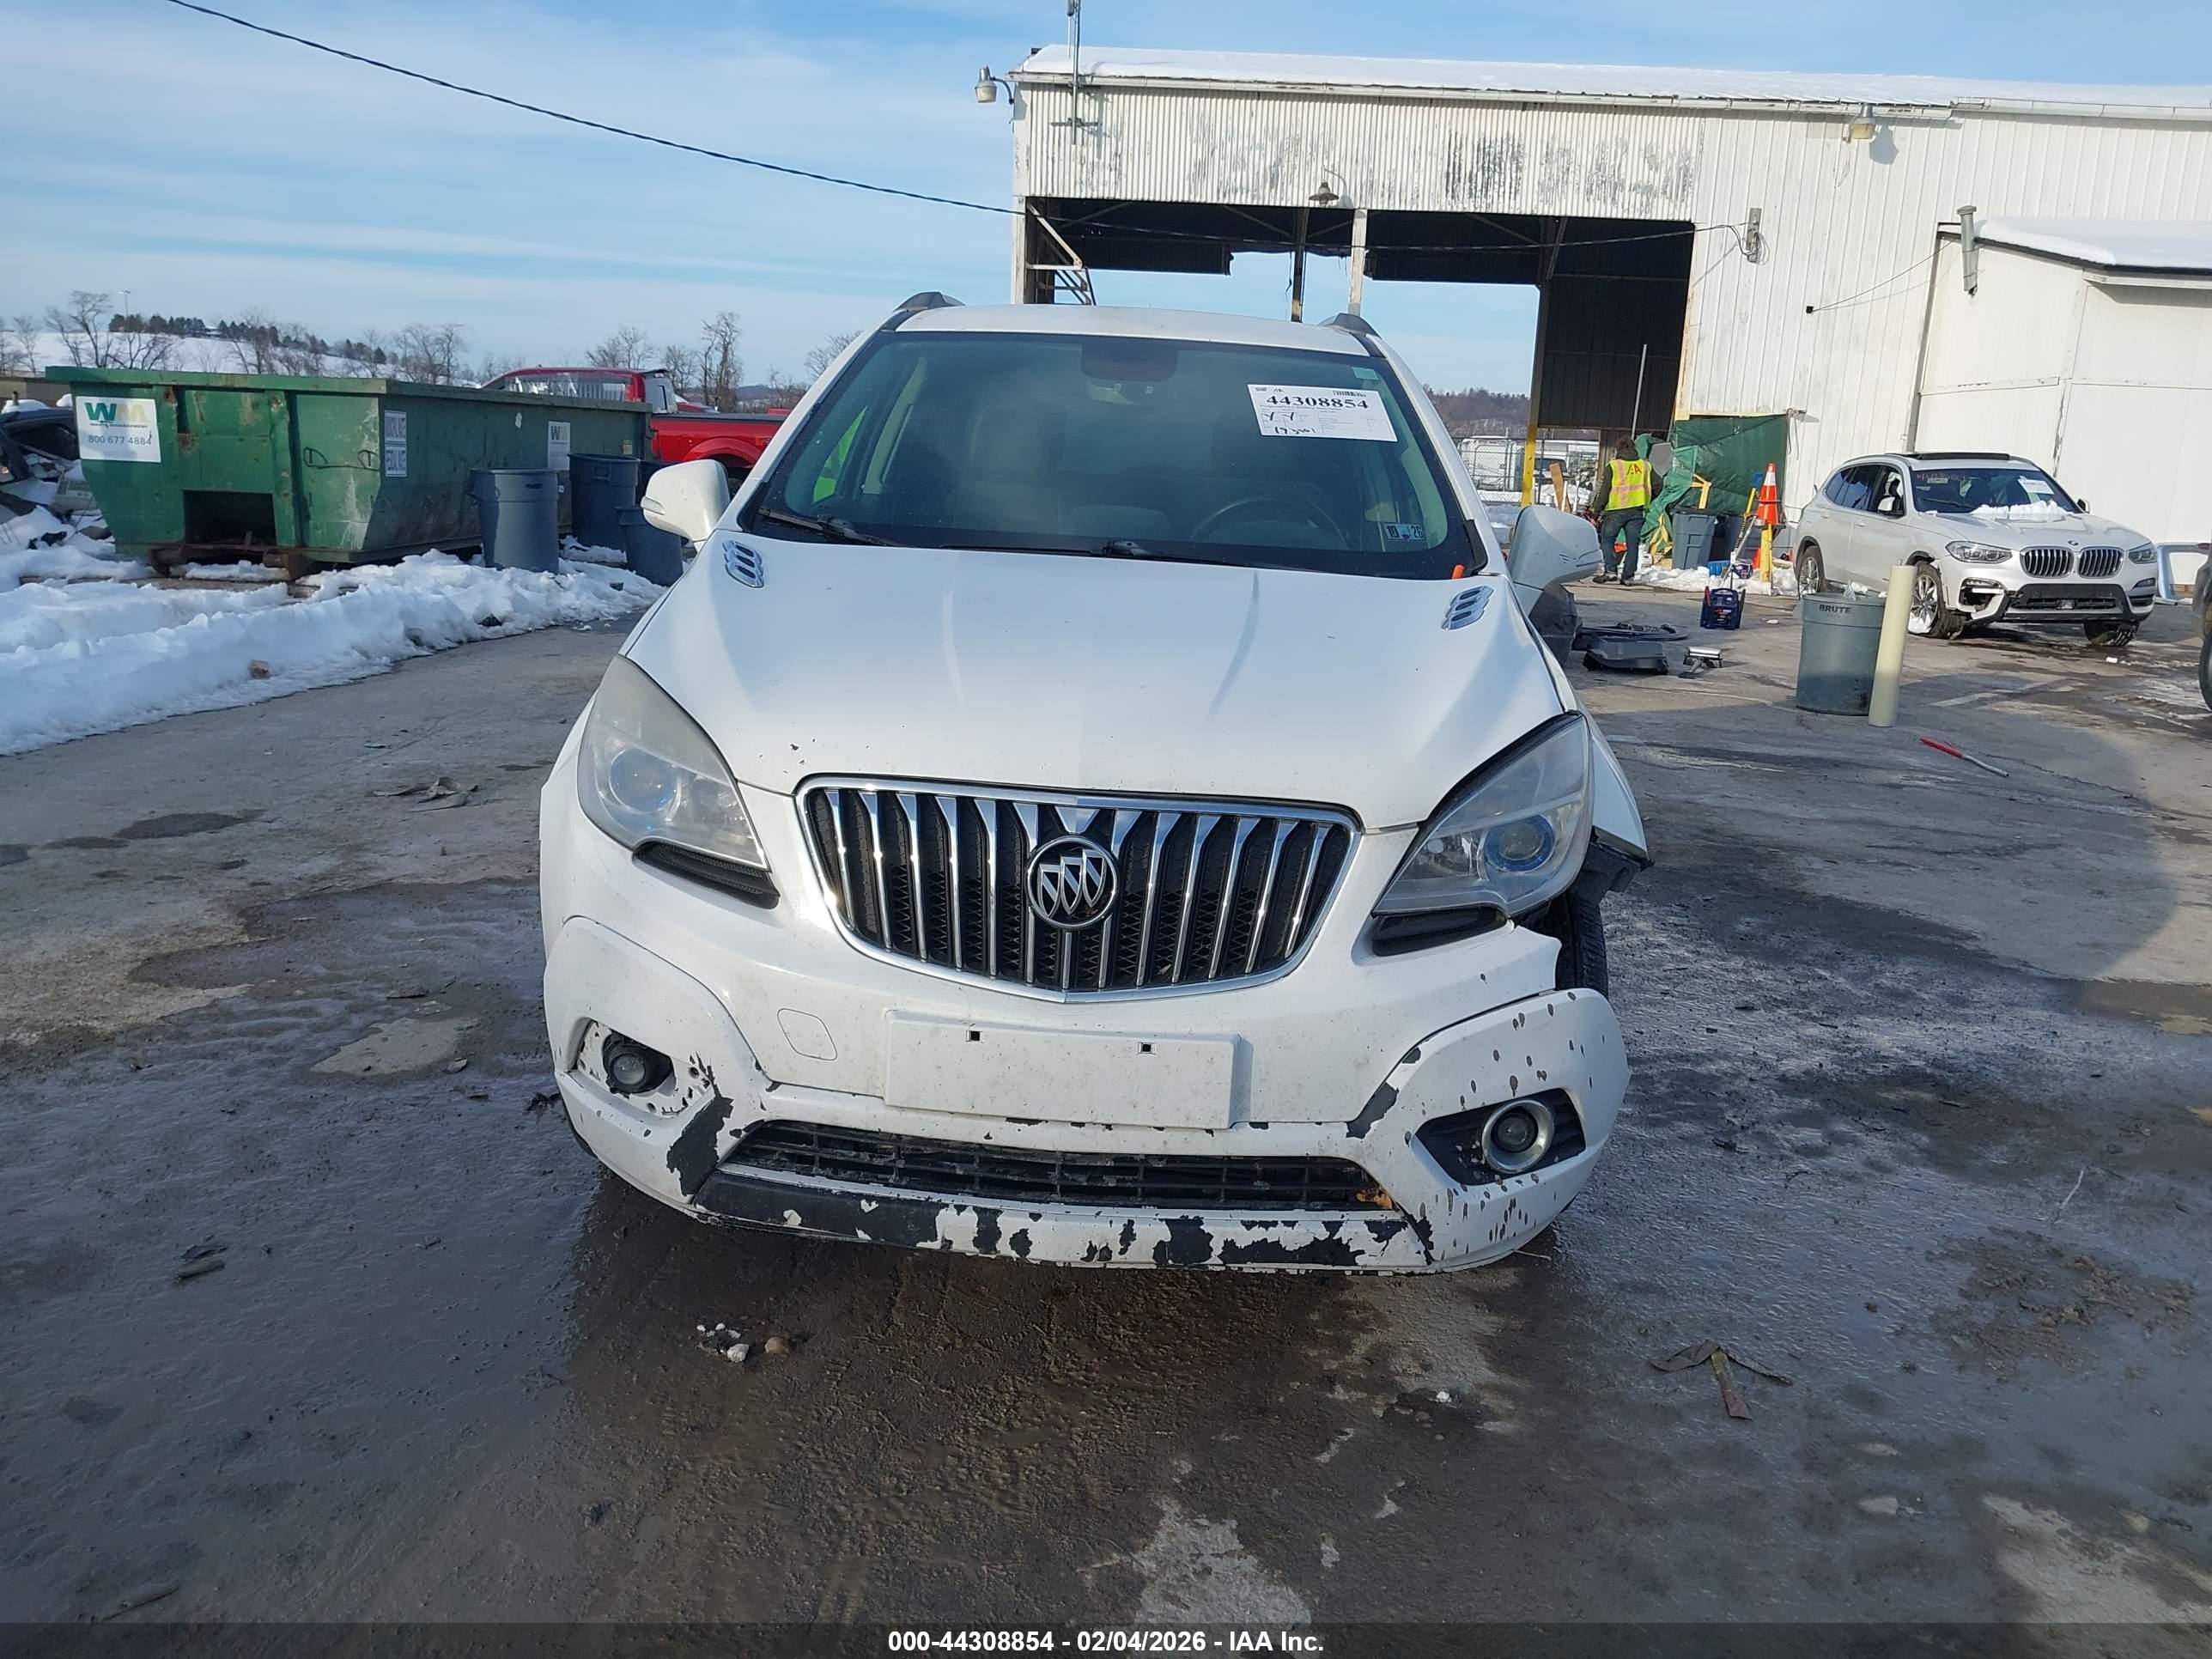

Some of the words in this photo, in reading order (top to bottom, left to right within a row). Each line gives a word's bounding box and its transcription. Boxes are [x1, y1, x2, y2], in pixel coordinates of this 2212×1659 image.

[1266, 395, 1369, 410] 44308854
[83, 402, 148, 422] WM
[107, 435, 125, 444] 677
[128, 436, 151, 446] 4884
[1411, 526, 1424, 538] 26
[1819, 604, 1852, 614] BRUTE
